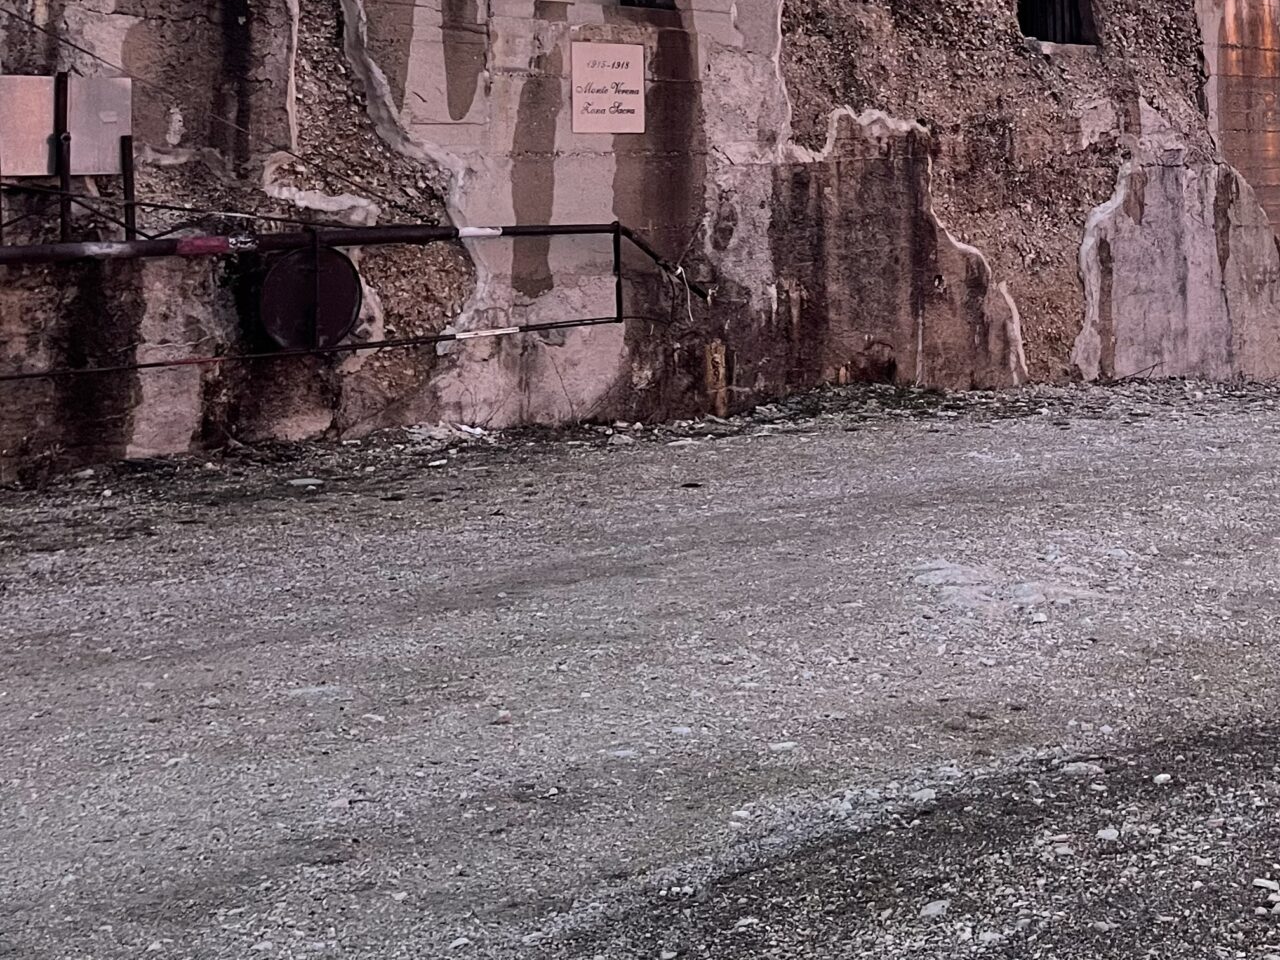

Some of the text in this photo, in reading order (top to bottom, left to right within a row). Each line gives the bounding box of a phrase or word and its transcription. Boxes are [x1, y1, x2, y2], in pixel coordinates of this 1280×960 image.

[576, 82, 640, 95] Monte Verena
[581, 101, 636, 115] Zona Sacra
